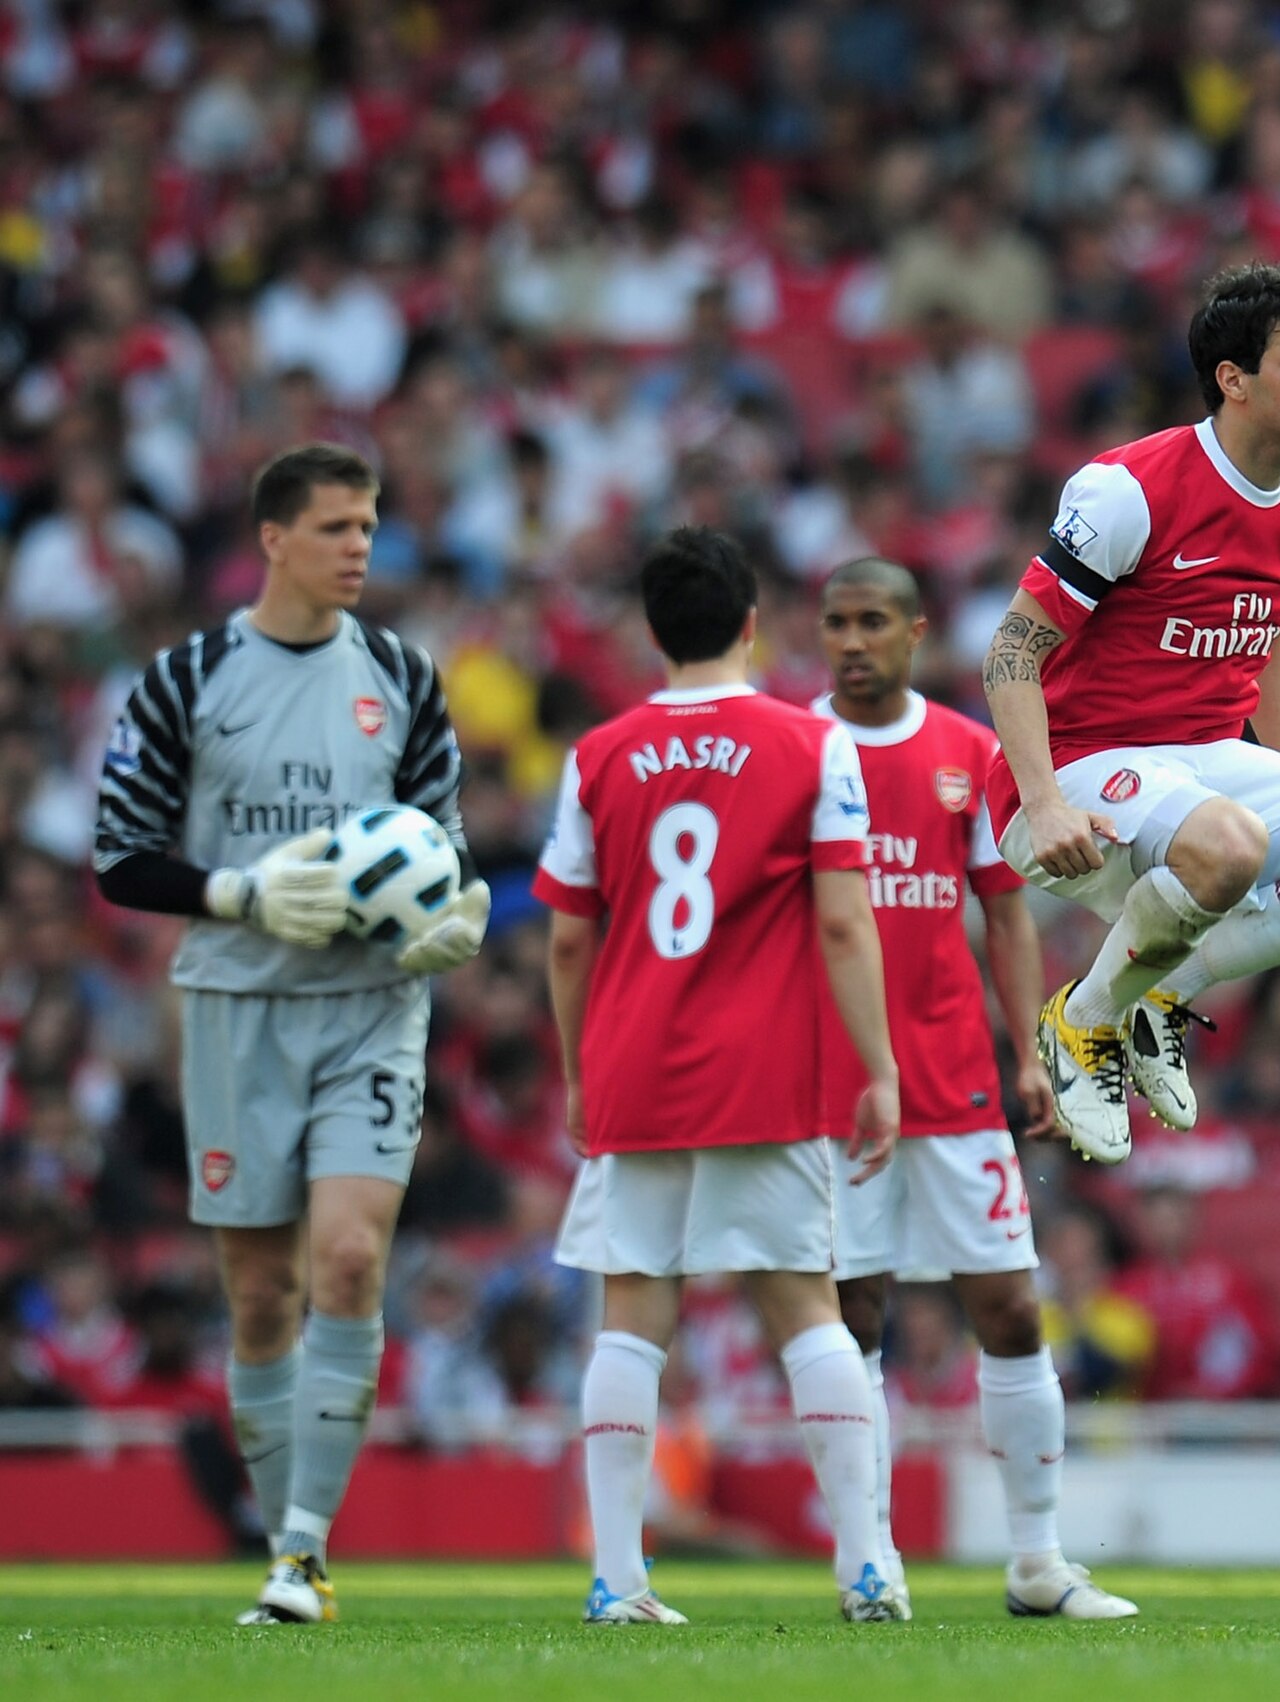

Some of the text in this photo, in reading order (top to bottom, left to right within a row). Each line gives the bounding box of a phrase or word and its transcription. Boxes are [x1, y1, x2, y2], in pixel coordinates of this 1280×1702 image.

[1232, 592, 1272, 622] Fly
[1159, 617, 1280, 658] Emirat
[283, 761, 332, 796] Fly
[628, 735, 752, 783] NASRI
[862, 833, 917, 868] Fly
[649, 801, 719, 961] 8
[868, 866, 958, 908] irates
